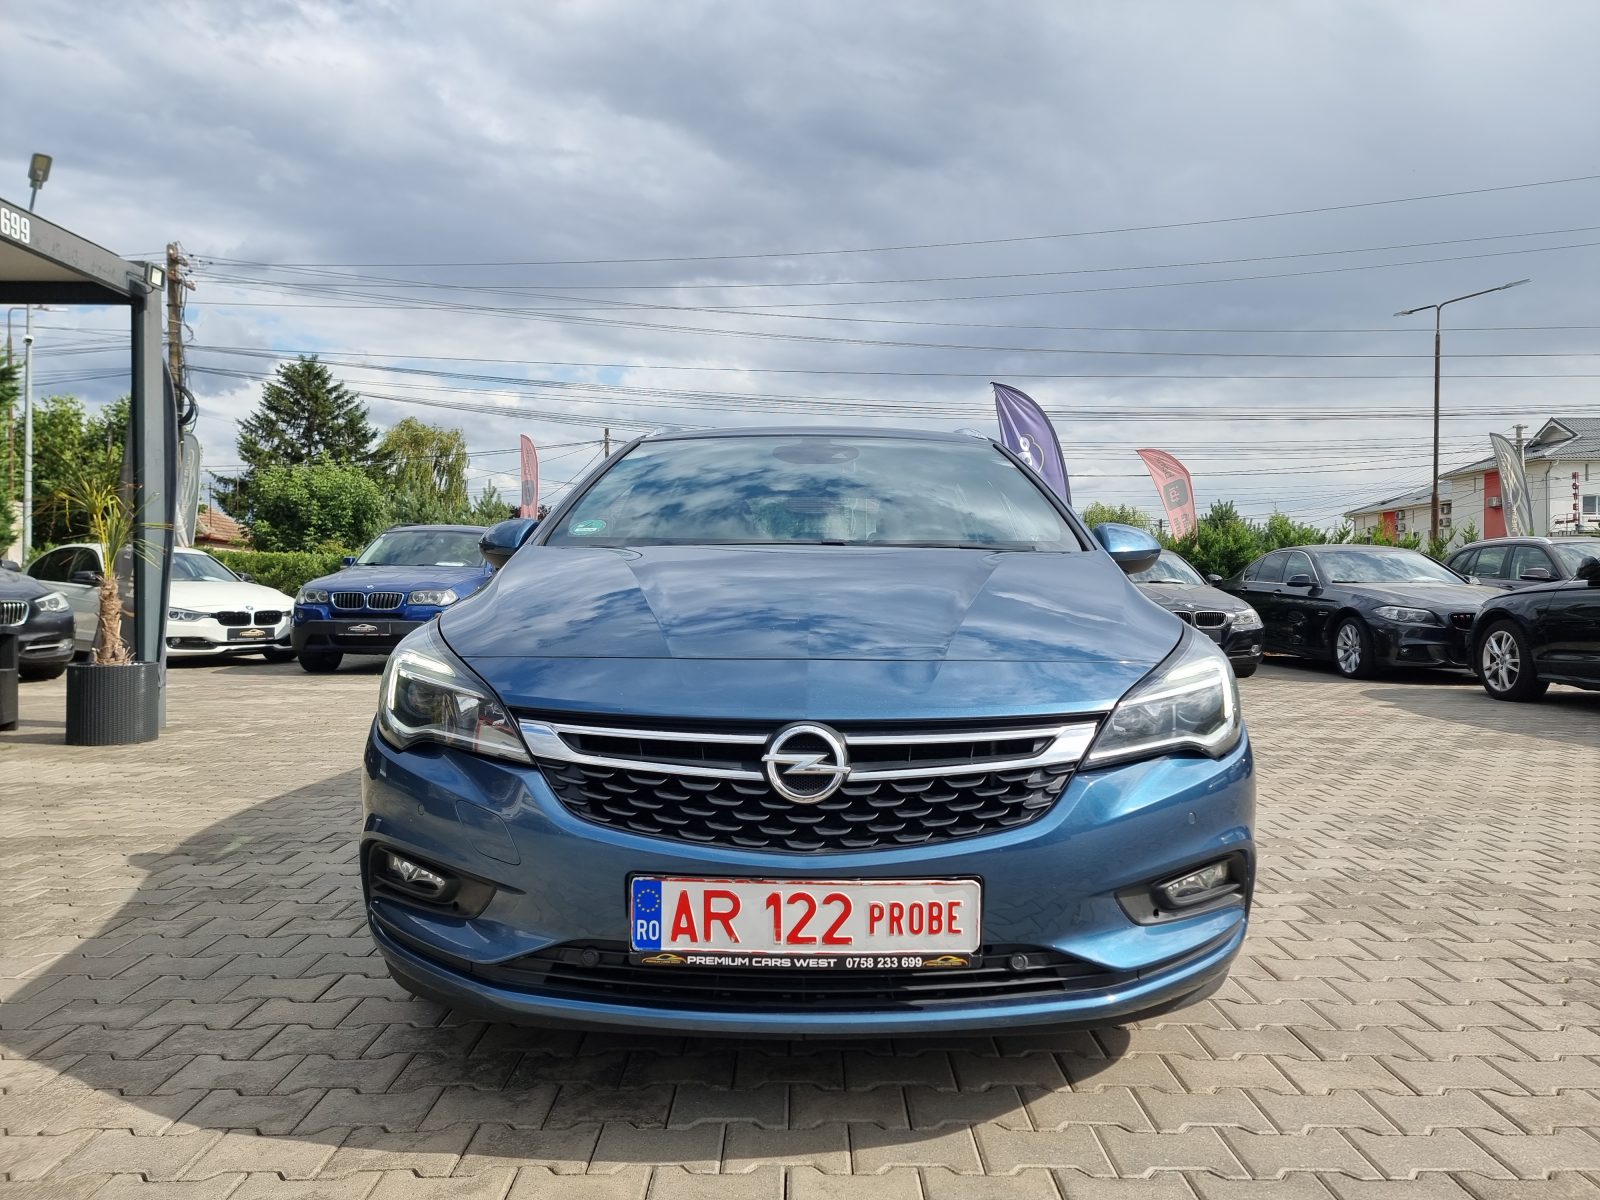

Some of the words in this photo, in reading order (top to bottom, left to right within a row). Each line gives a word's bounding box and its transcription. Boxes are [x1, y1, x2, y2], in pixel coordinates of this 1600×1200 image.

[0, 207, 30, 244] 699
[636, 919, 660, 941] RO
[670, 889, 741, 943] AR
[765, 891, 853, 945] 122
[868, 900, 964, 936] PROBE
[687, 955, 749, 966] PREMIUM
[752, 958, 791, 967] CARS
[794, 958, 838, 968] WEST
[846, 957, 874, 968] 0758
[877, 957, 899, 968] 233
[901, 956, 922, 968] 699
